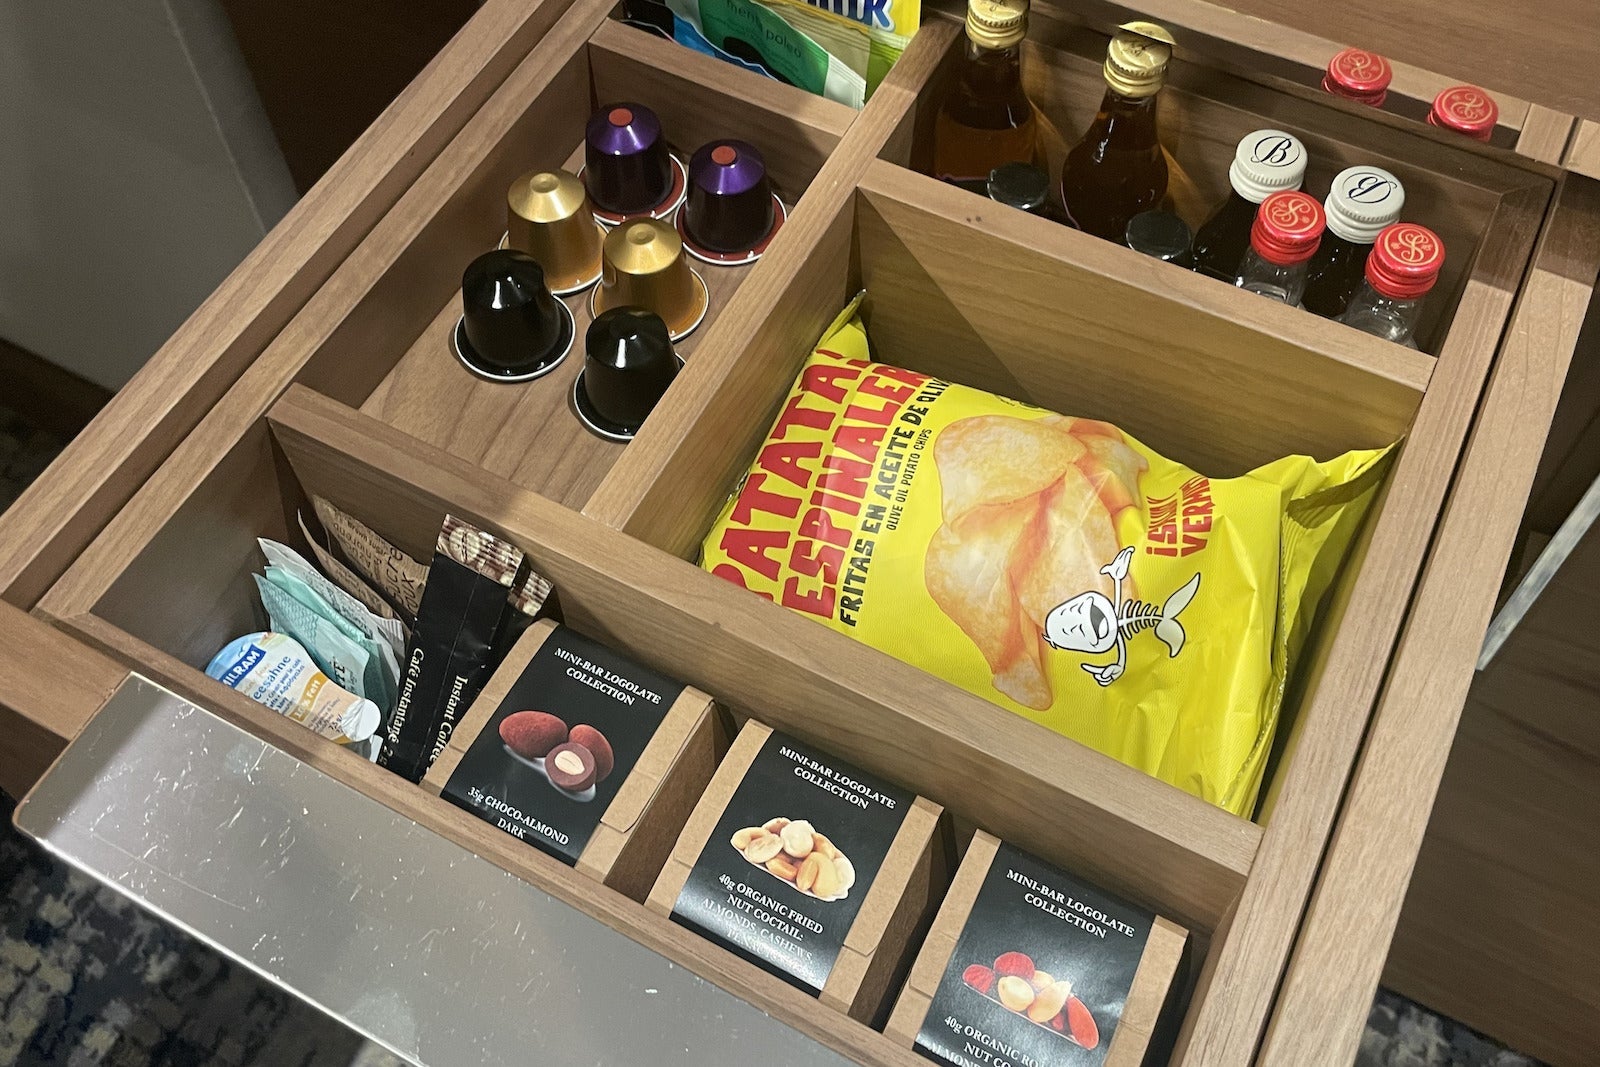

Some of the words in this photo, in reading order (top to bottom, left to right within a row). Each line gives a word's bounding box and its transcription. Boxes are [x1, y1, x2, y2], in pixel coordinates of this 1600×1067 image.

[913, 428, 932, 451] CHIPS
[901, 452, 921, 486] POTATO
[781, 366, 933, 620] ESPINALER
[840, 538, 875, 627] FRITAS
[861, 504, 886, 535] EN
[874, 426, 916, 501] ACEITE
[900, 404, 929, 426] DE
[916, 377, 952, 402] OLIV
[895, 488, 909, 503] OIL
[886, 503, 904, 531] OLIVE
[408, 647, 425, 678] Café
[554, 647, 605, 676] MINI-BAR
[603, 668, 662, 705] LOGOLATE
[444, 675, 469, 721] Instant
[566, 667, 636, 706] COLLECTION
[387, 677, 417, 744] Instantané
[779, 745, 834, 778] MINI-BAR
[833, 771, 898, 809] LOGOLATE
[793, 766, 870, 810] COLLECTION
[467, 786, 485, 804] 35g
[484, 795, 570, 846] CHOCO-ALMOND
[497, 817, 528, 840] DARK
[718, 873, 736, 892] 40g
[736, 882, 788, 917] ORGANIC
[788, 909, 824, 935] FRIED
[727, 893, 753, 914] NUT
[753, 908, 805, 942] COCTAIL:
[1006, 869, 1065, 903] MINI-BAR
[1066, 898, 1136, 938] LOGOLATE
[1024, 893, 1107, 939] COLLECTION
[944, 1015, 963, 1035] 40g
[964, 1025, 1020, 1060] ORGANIC
[963, 1041, 993, 1063] NUT
